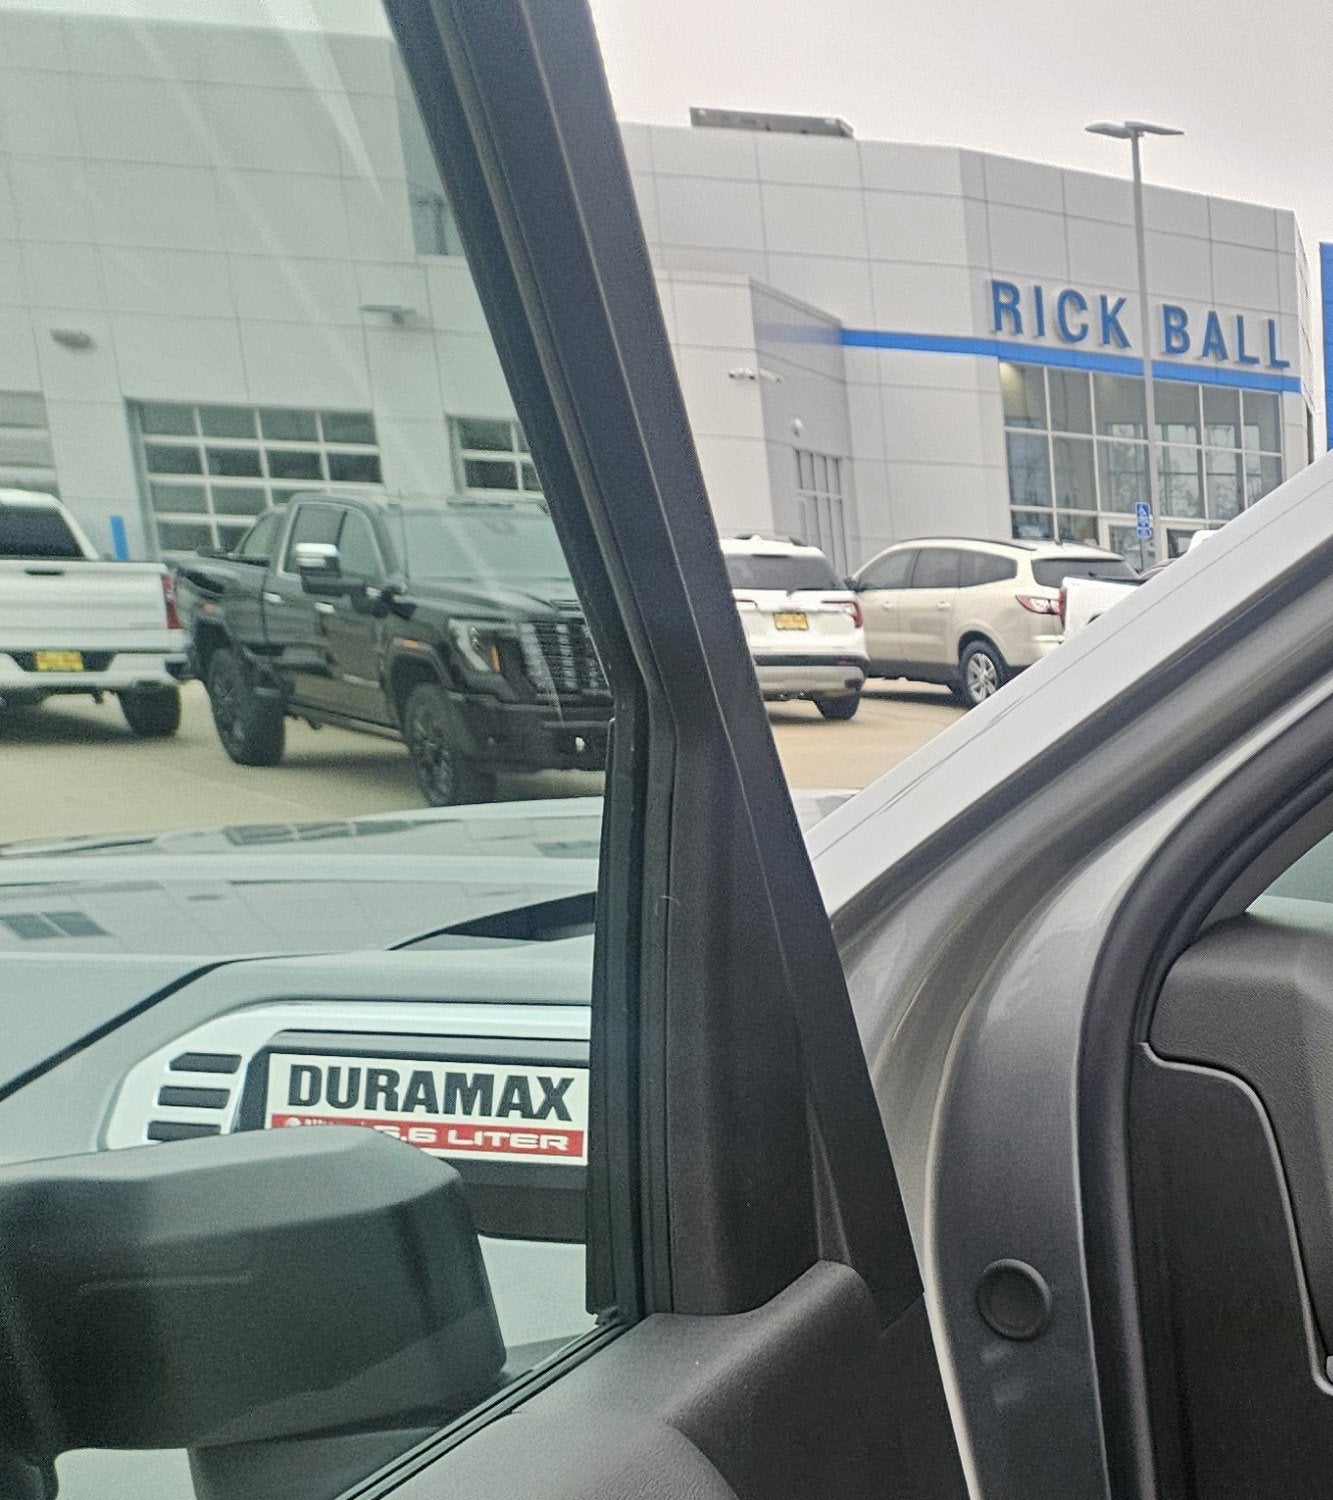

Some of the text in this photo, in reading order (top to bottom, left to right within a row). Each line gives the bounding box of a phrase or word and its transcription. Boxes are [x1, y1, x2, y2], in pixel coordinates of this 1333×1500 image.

[990, 278, 1291, 369] RICK BALL
[287, 1063, 576, 1123] DURAMAX
[446, 1129, 571, 1151] LITER
